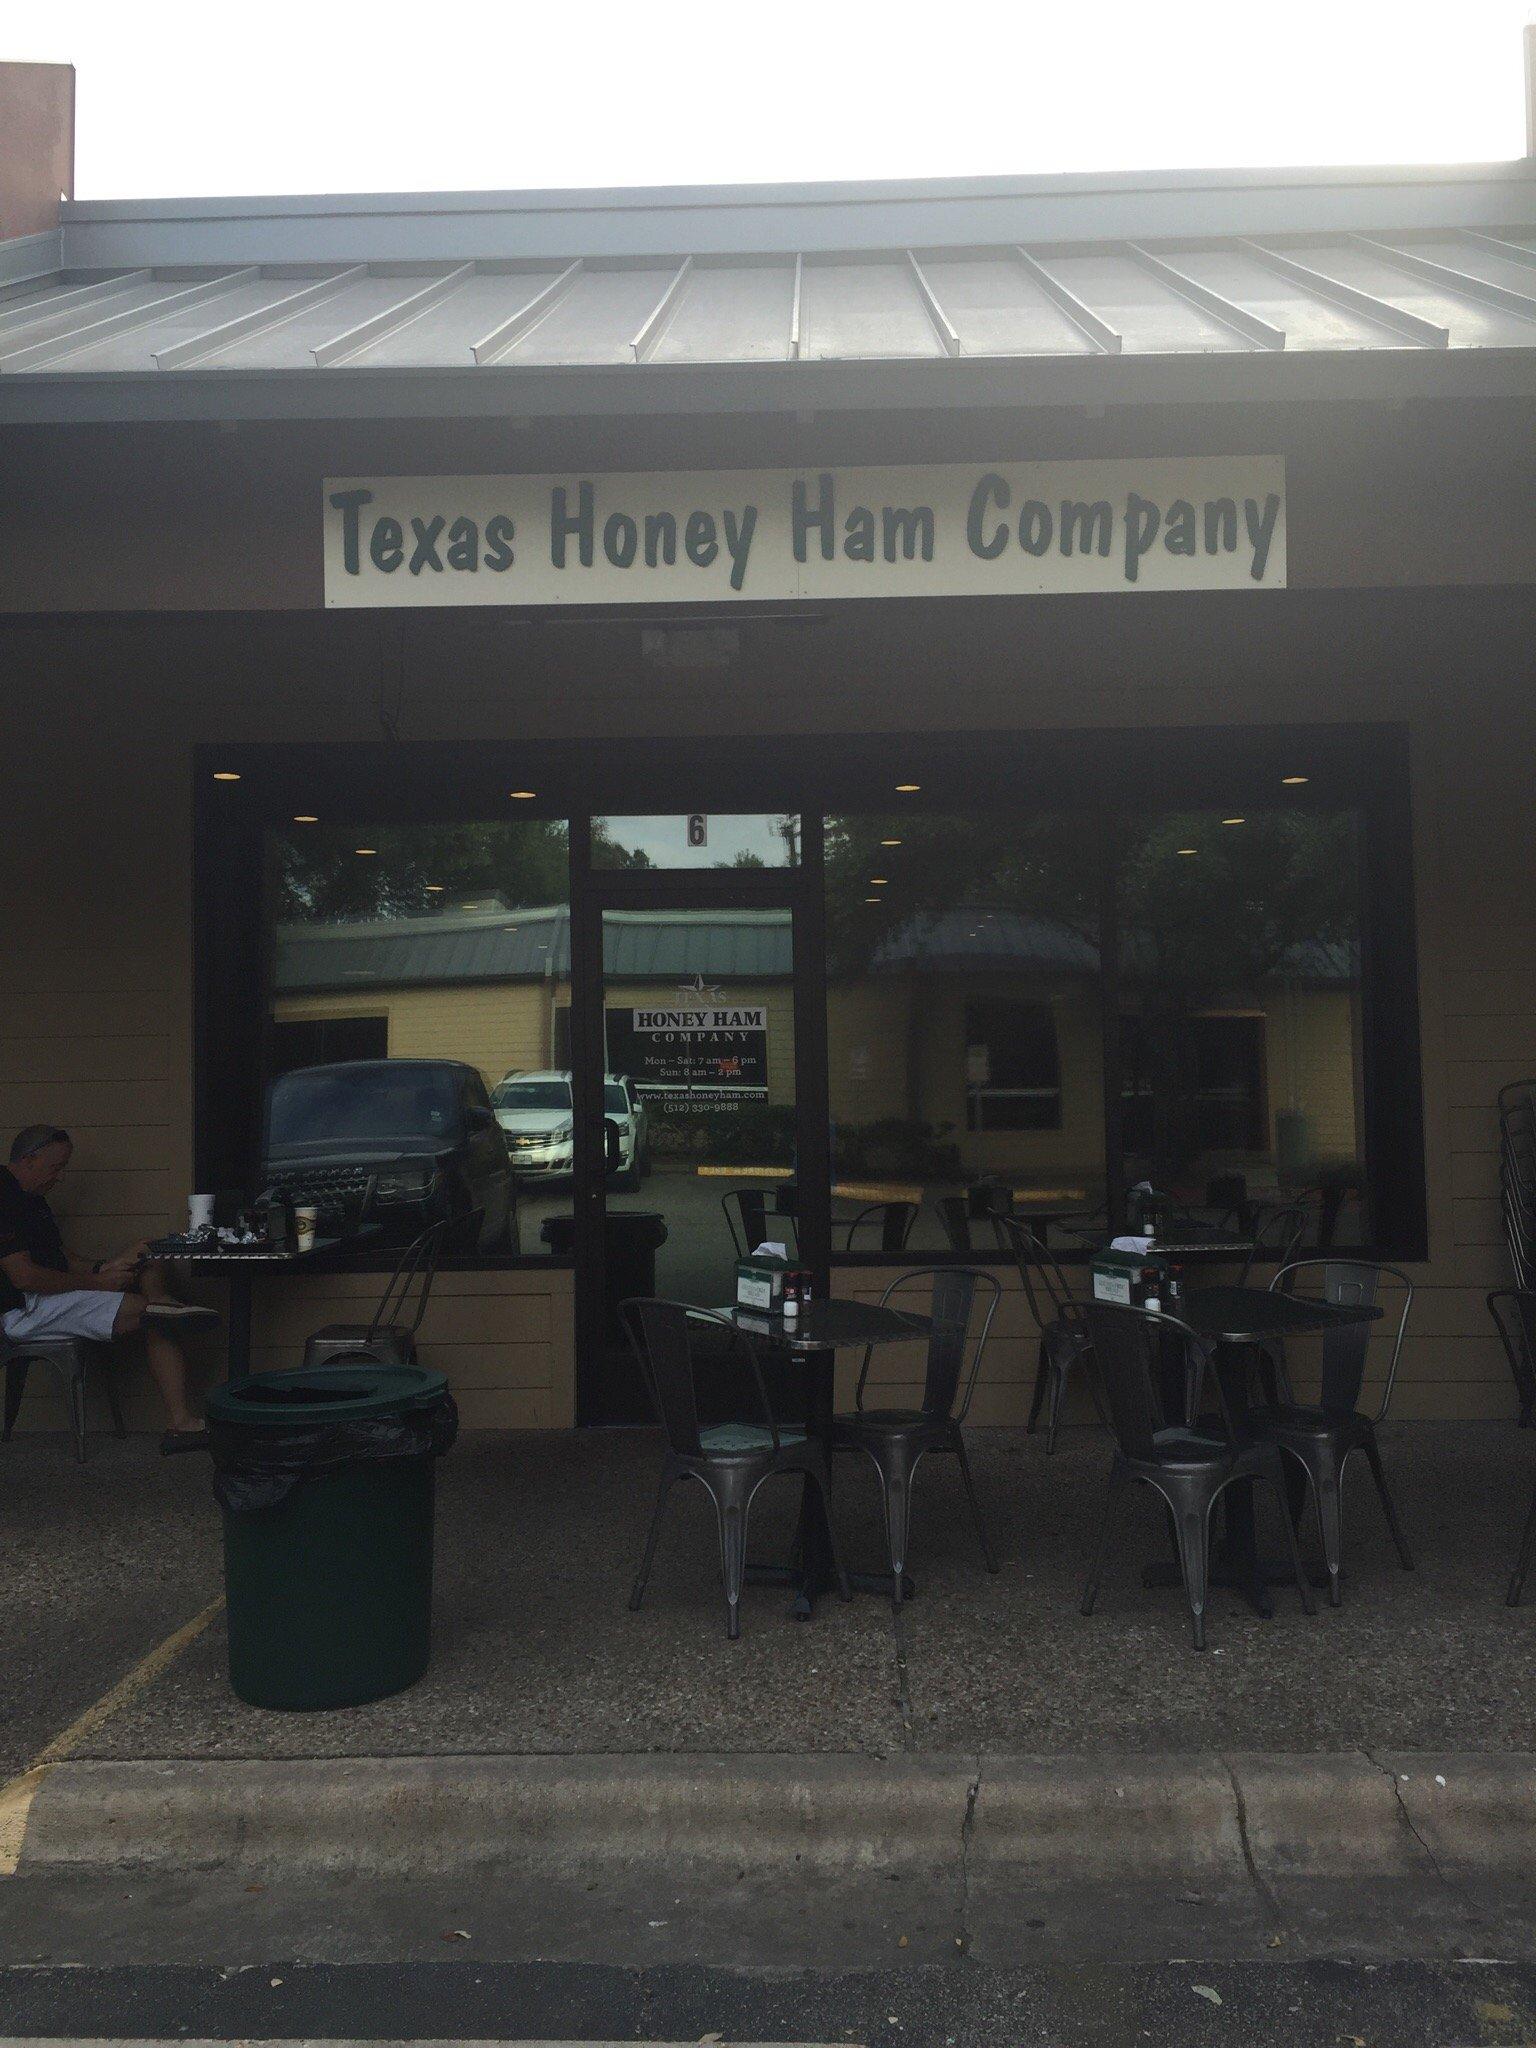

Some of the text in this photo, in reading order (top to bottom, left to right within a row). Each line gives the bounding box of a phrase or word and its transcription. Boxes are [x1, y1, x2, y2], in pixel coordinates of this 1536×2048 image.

[328, 472, 1280, 591] Texas Honey Ham Company
[689, 814, 705, 845] 6
[637, 1010, 762, 1028] HONEY HAM
[651, 1031, 750, 1043] COMPANY
[644, 1056, 667, 1065] Mon
[677, 1056, 697, 1065] Sat:
[699, 1057, 705, 1066] 7
[731, 1056, 740, 1065] 6
[741, 1057, 757, 1067] pm
[660, 1067, 681, 1077] Sun:
[683, 1067, 691, 1076] 8
[717, 1068, 725, 1077] 2
[726, 1068, 742, 1078] pm
[636, 1090, 765, 1101] www.texashoneyham.com
[663, 1102, 690, 1113] (512)
